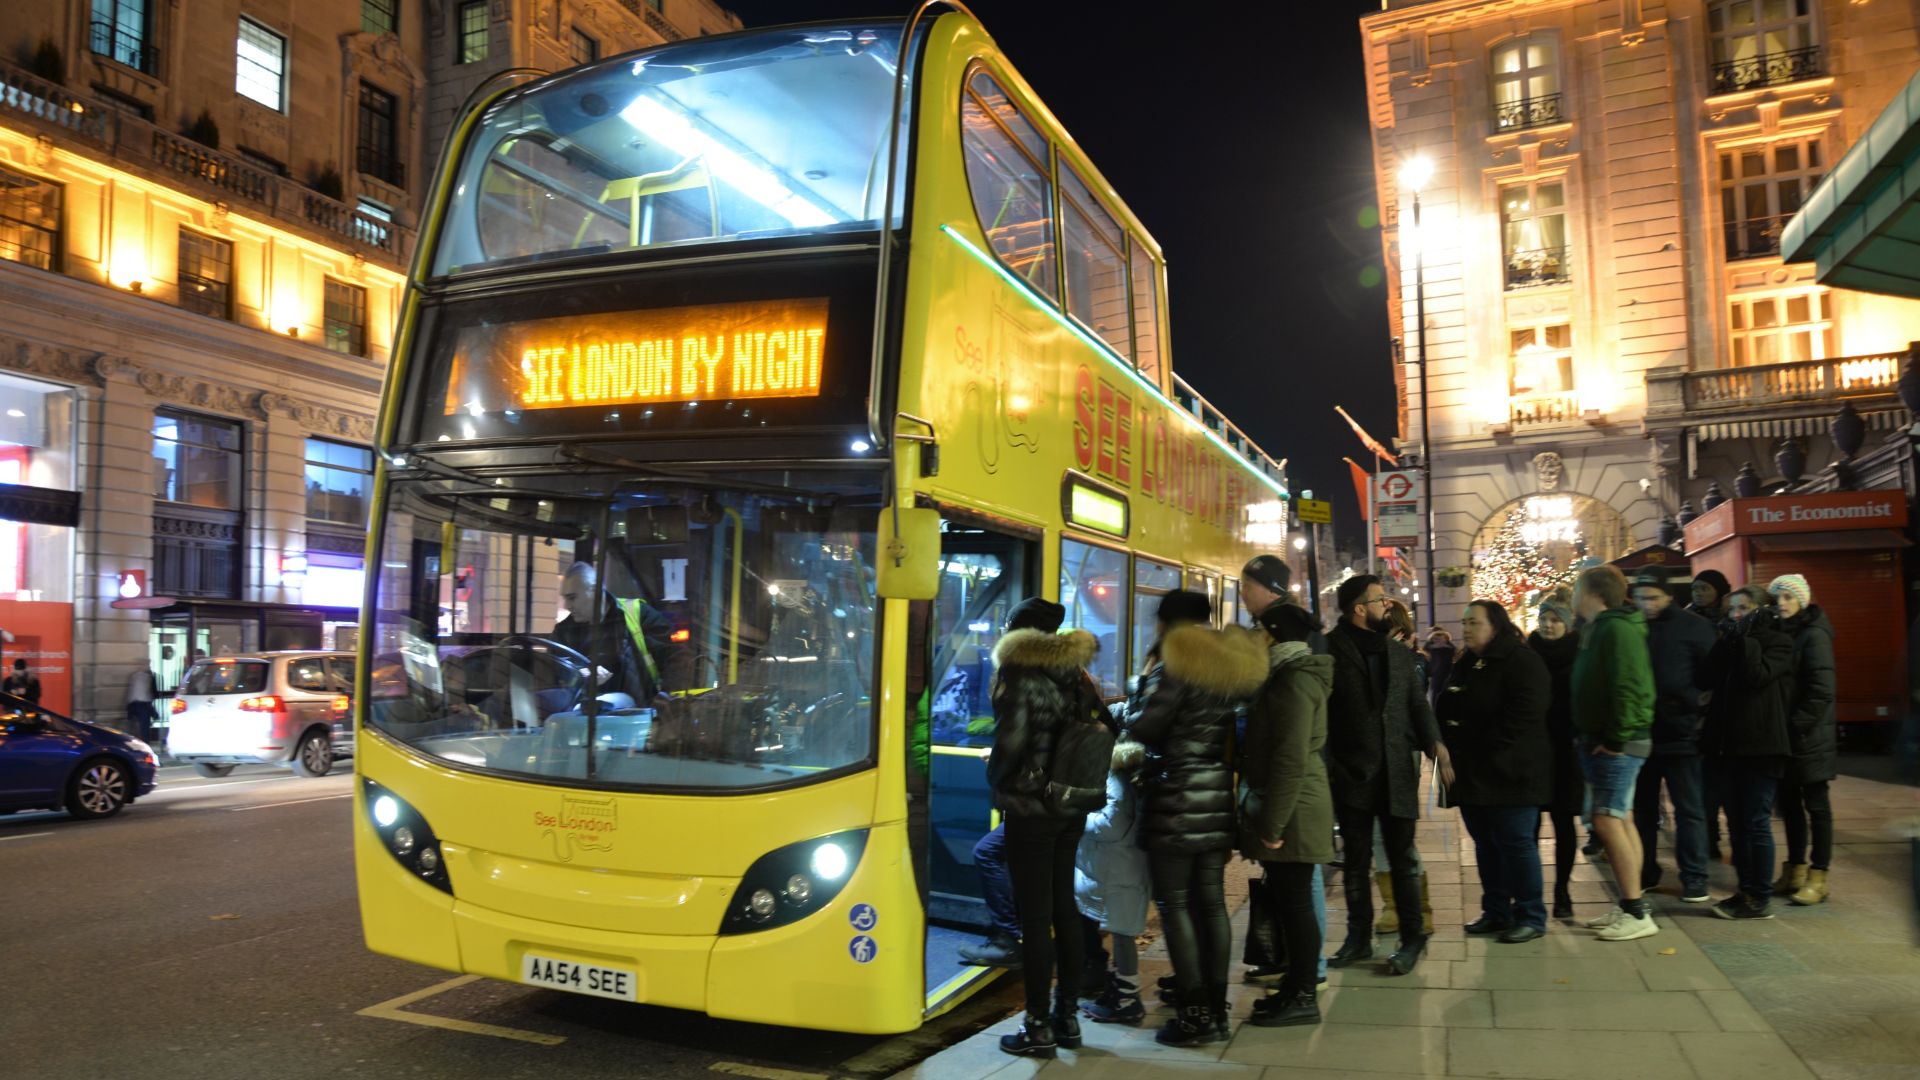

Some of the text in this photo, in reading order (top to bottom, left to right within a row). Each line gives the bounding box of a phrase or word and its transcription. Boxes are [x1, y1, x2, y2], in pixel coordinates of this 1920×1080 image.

[522, 329, 823, 403] SEE LONDON BY NIGHT
[1074, 364, 1132, 489] SEE
[1140, 406, 1222, 527] LONDON
[1747, 501, 1892, 523] The Economist
[534, 811, 614, 833] See London
[531, 958, 627, 995] AA54 SEE
